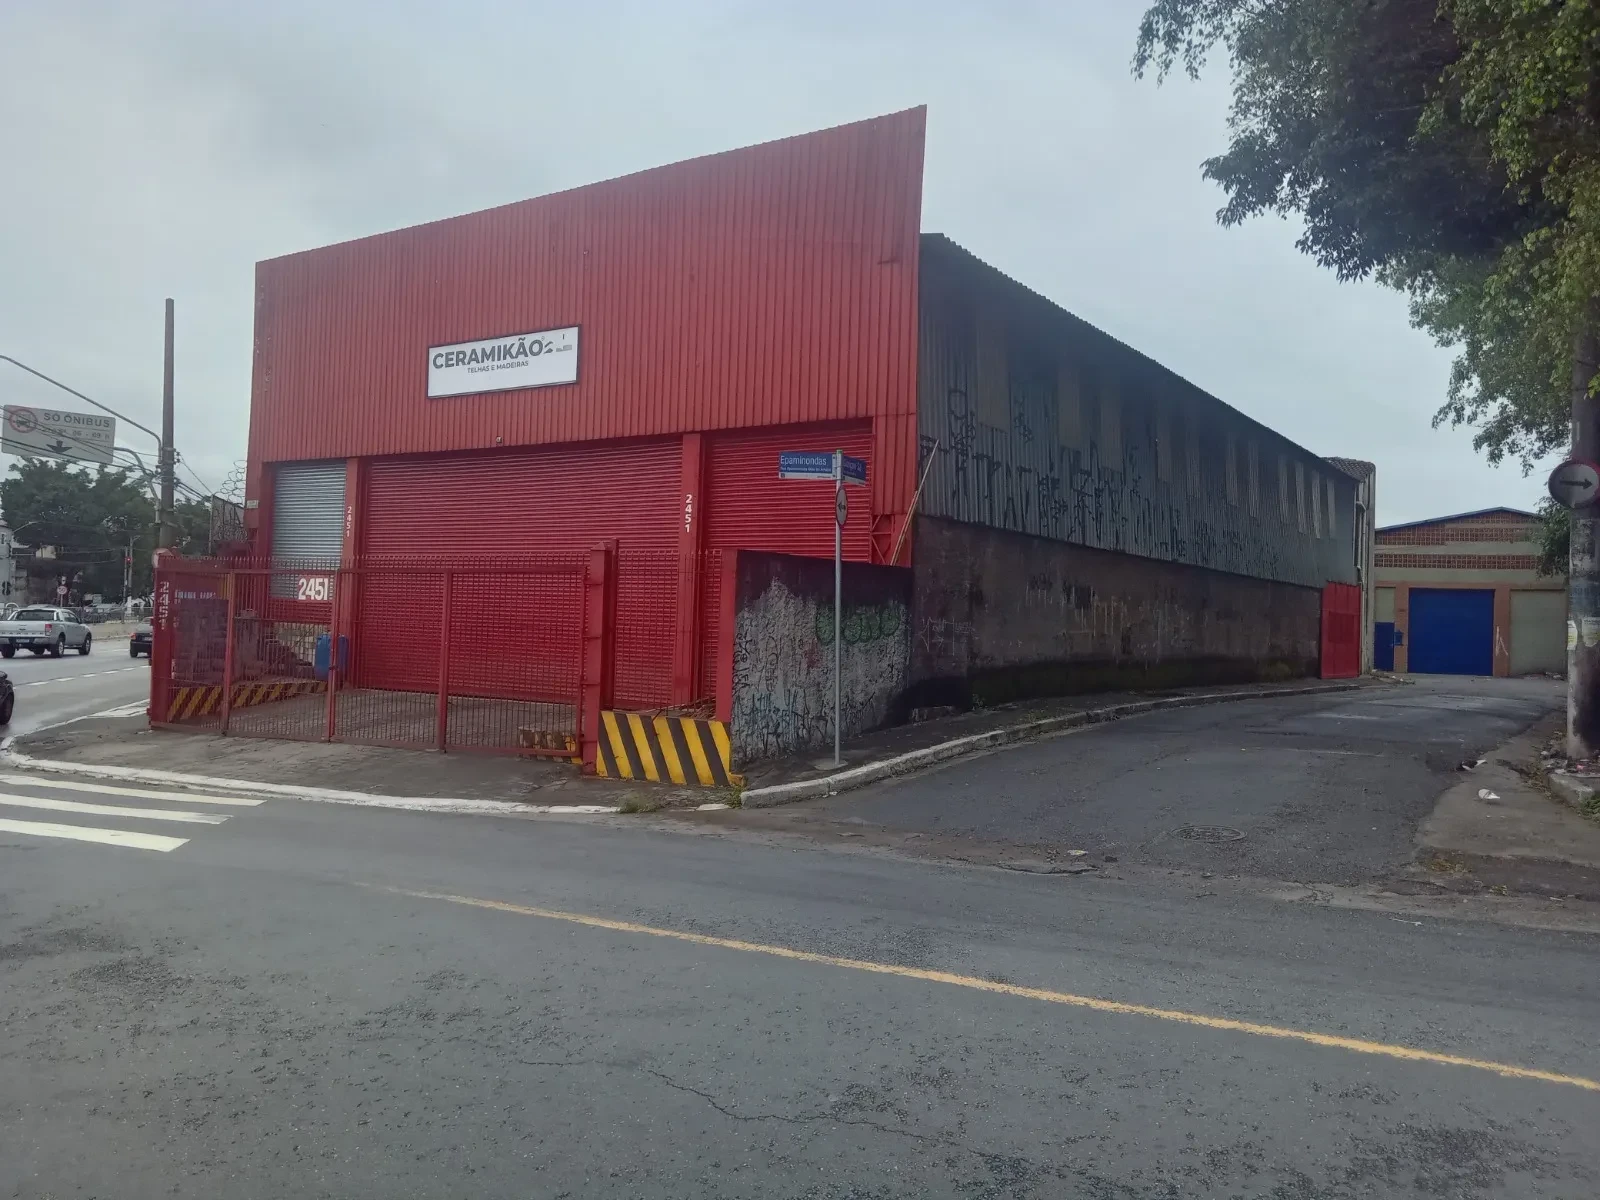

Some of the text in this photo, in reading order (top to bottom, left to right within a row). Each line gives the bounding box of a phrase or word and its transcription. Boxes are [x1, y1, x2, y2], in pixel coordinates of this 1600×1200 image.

[432, 337, 544, 369] CERAMIKÃO
[467, 364, 490, 374] TELHAS
[497, 360, 529, 371] MADEIRAS
[64, 413, 110, 428] ÔNIBUS
[780, 455, 827, 466] Epaminondas
[298, 577, 329, 601] 2451
[159, 581, 170, 630] 2451
